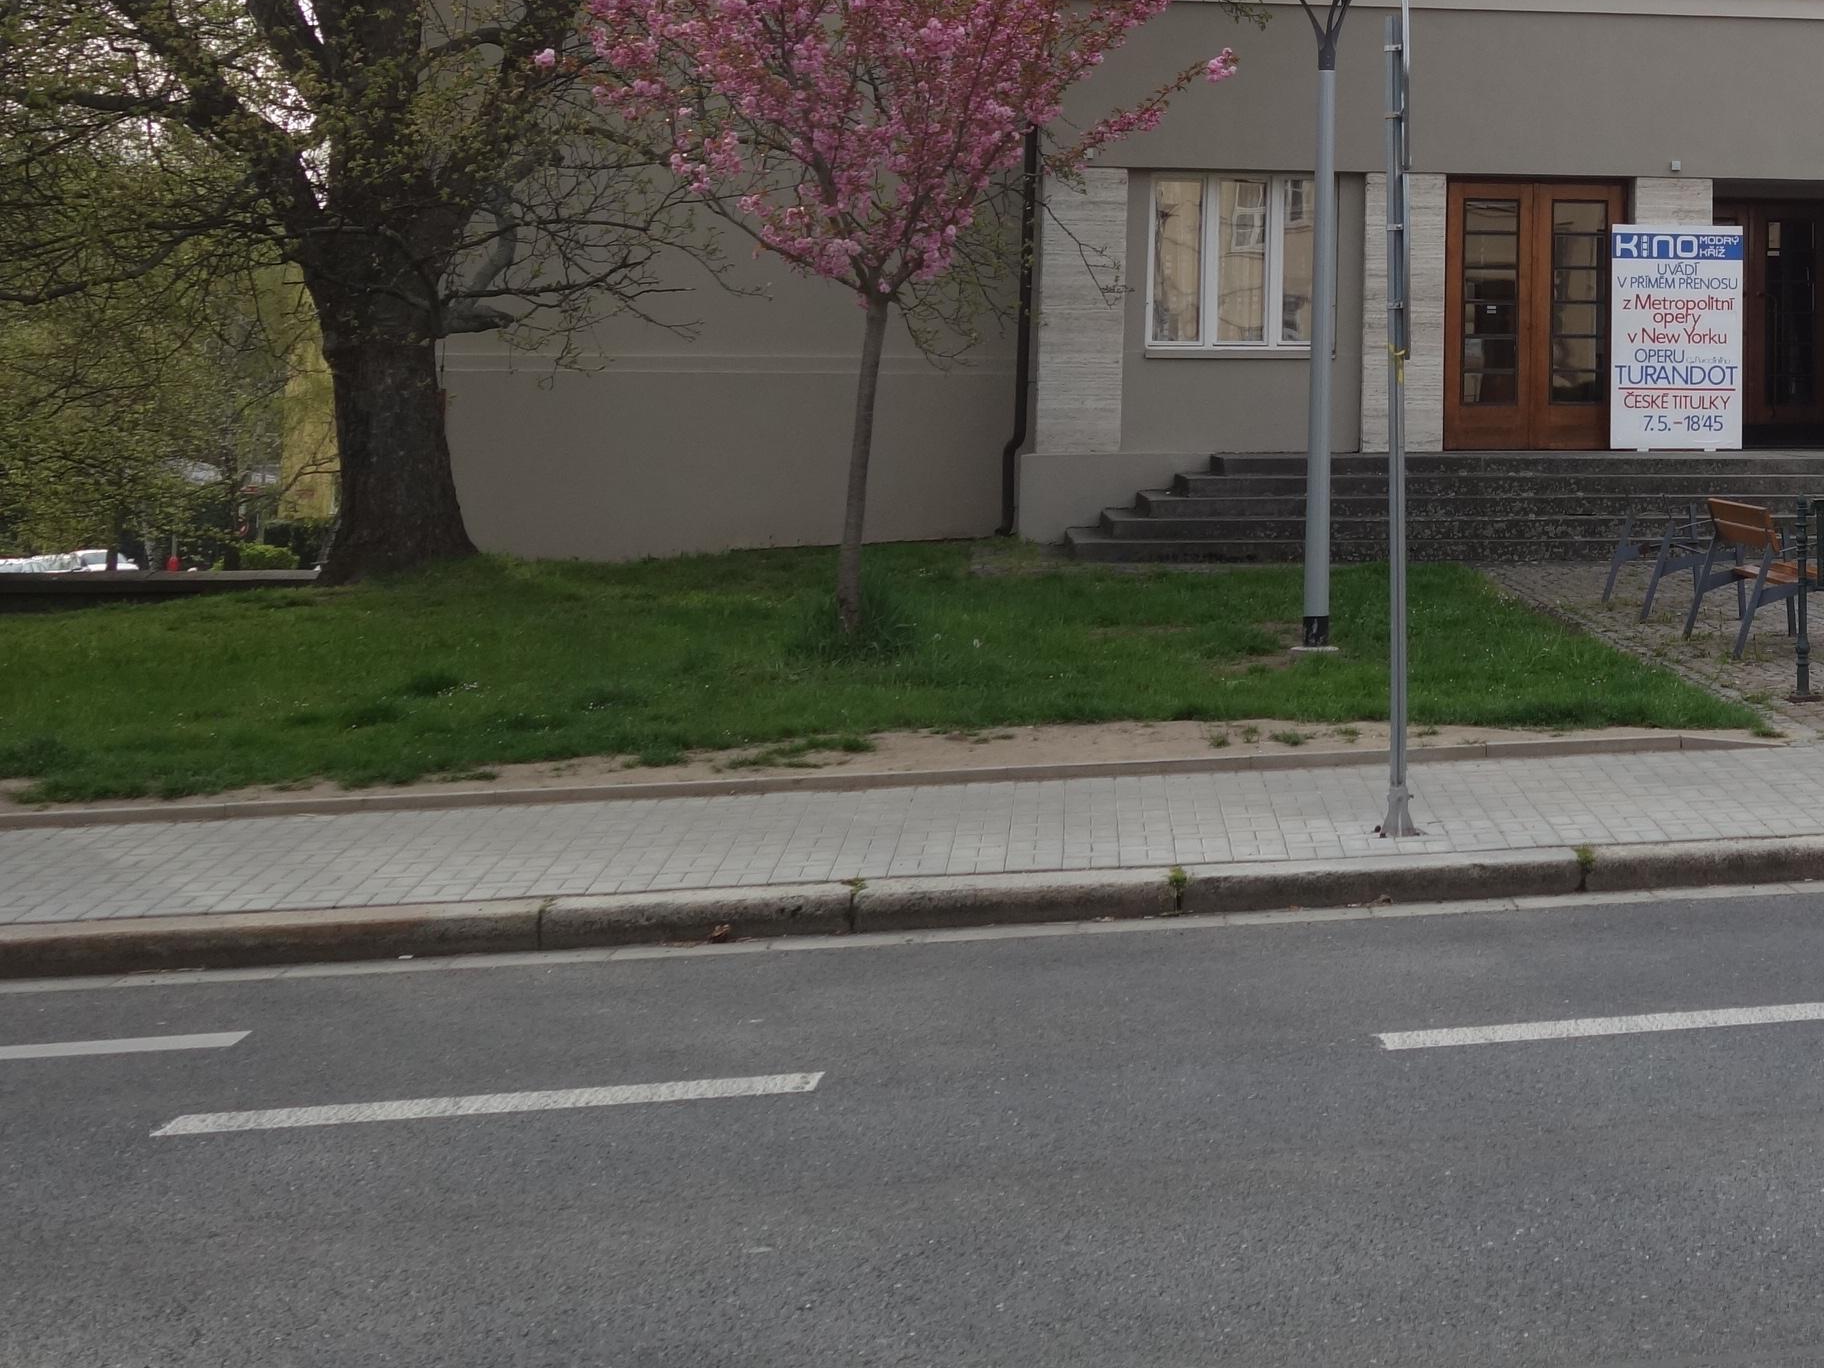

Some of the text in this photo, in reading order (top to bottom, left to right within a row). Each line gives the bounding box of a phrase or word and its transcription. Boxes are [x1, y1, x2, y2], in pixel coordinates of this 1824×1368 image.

[1700, 235, 1740, 246] MODRÝ
[1700, 246, 1726, 258] KŘÍŽ
[1657, 262, 1700, 276] UVÁDÍ
[1617, 275, 1738, 290] V PŘÍMÉM PŘENOSU
[1622, 294, 1735, 314] z Metropolitní
[1653, 312, 1702, 331] opery
[1641, 327, 1681, 344] New
[1683, 327, 1727, 345] Yorku
[1634, 348, 1685, 364] OPERU
[1614, 365, 1738, 385] TURANDOT
[1623, 391, 1731, 410] ČESKÉ TITULKY
